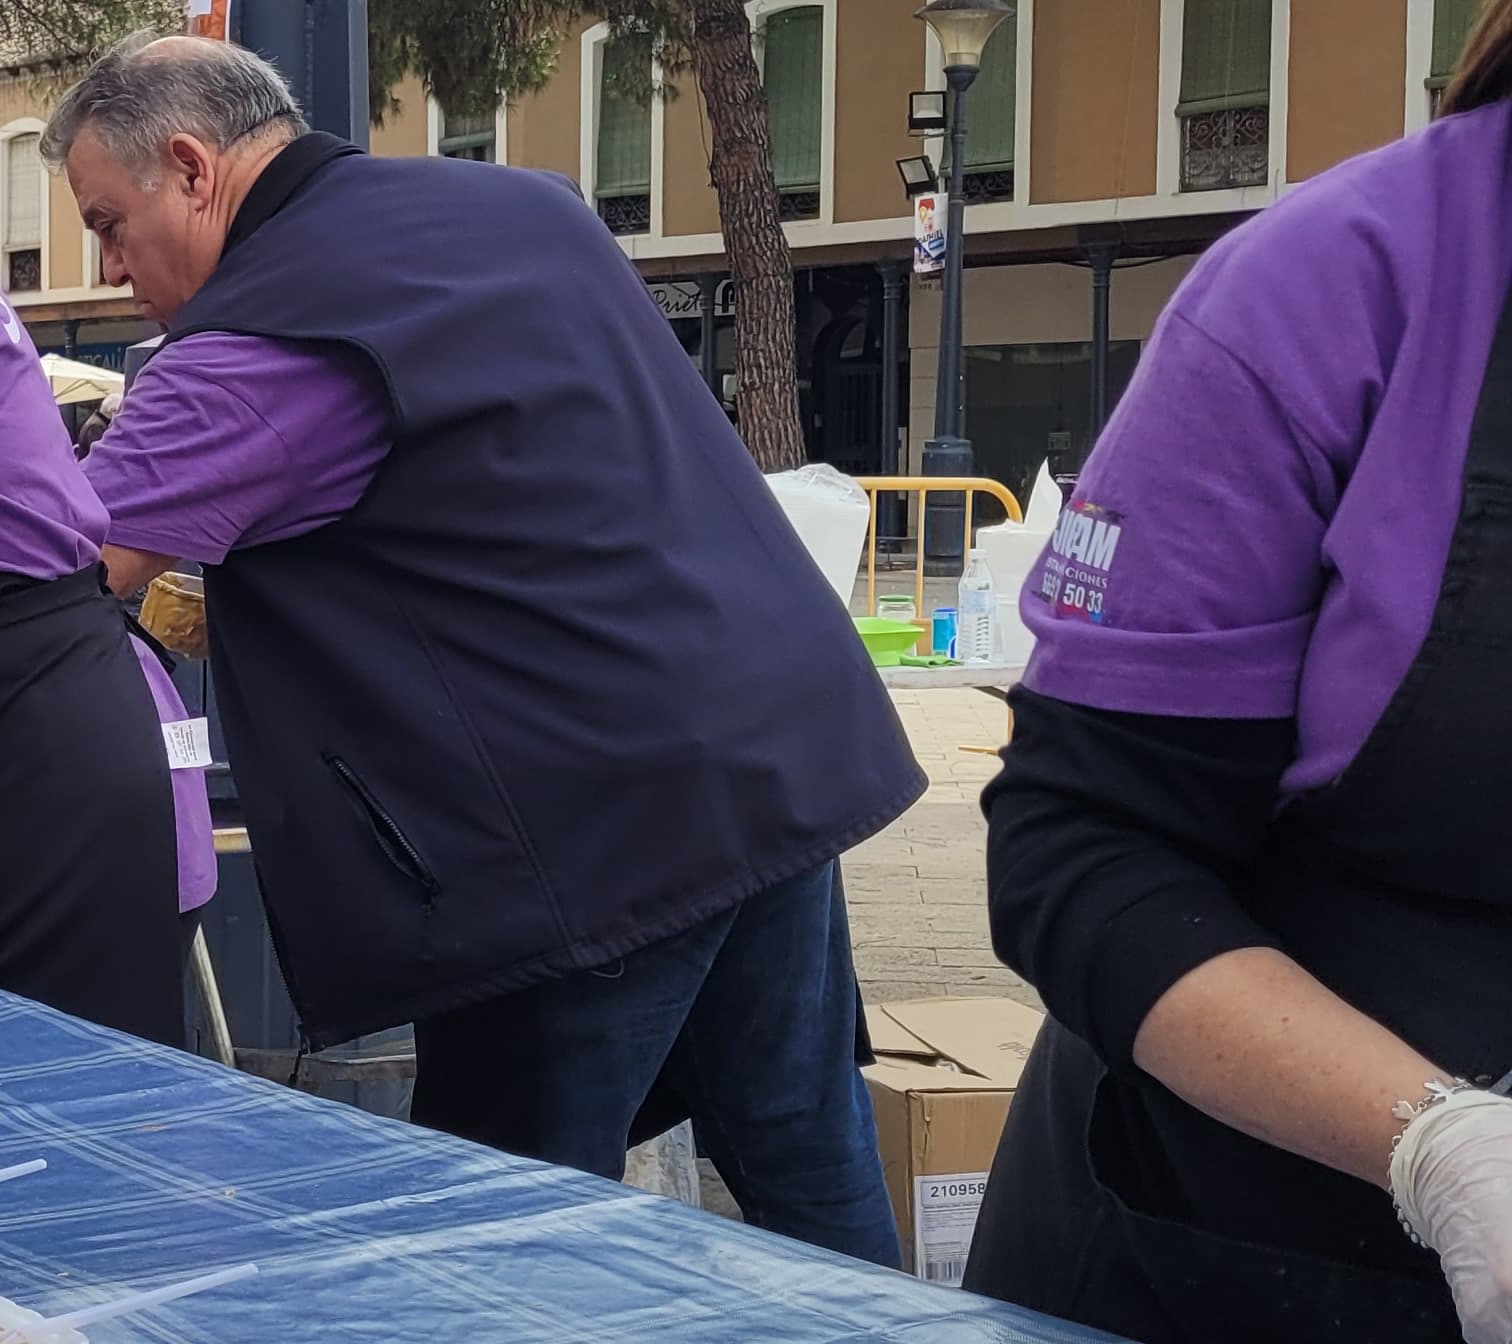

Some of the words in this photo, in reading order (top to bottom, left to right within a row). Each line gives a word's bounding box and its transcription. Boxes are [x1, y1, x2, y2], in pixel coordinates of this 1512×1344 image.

[652, 289, 704, 313] Priet
[1063, 583, 1085, 609] 50
[1087, 590, 1103, 614] 33
